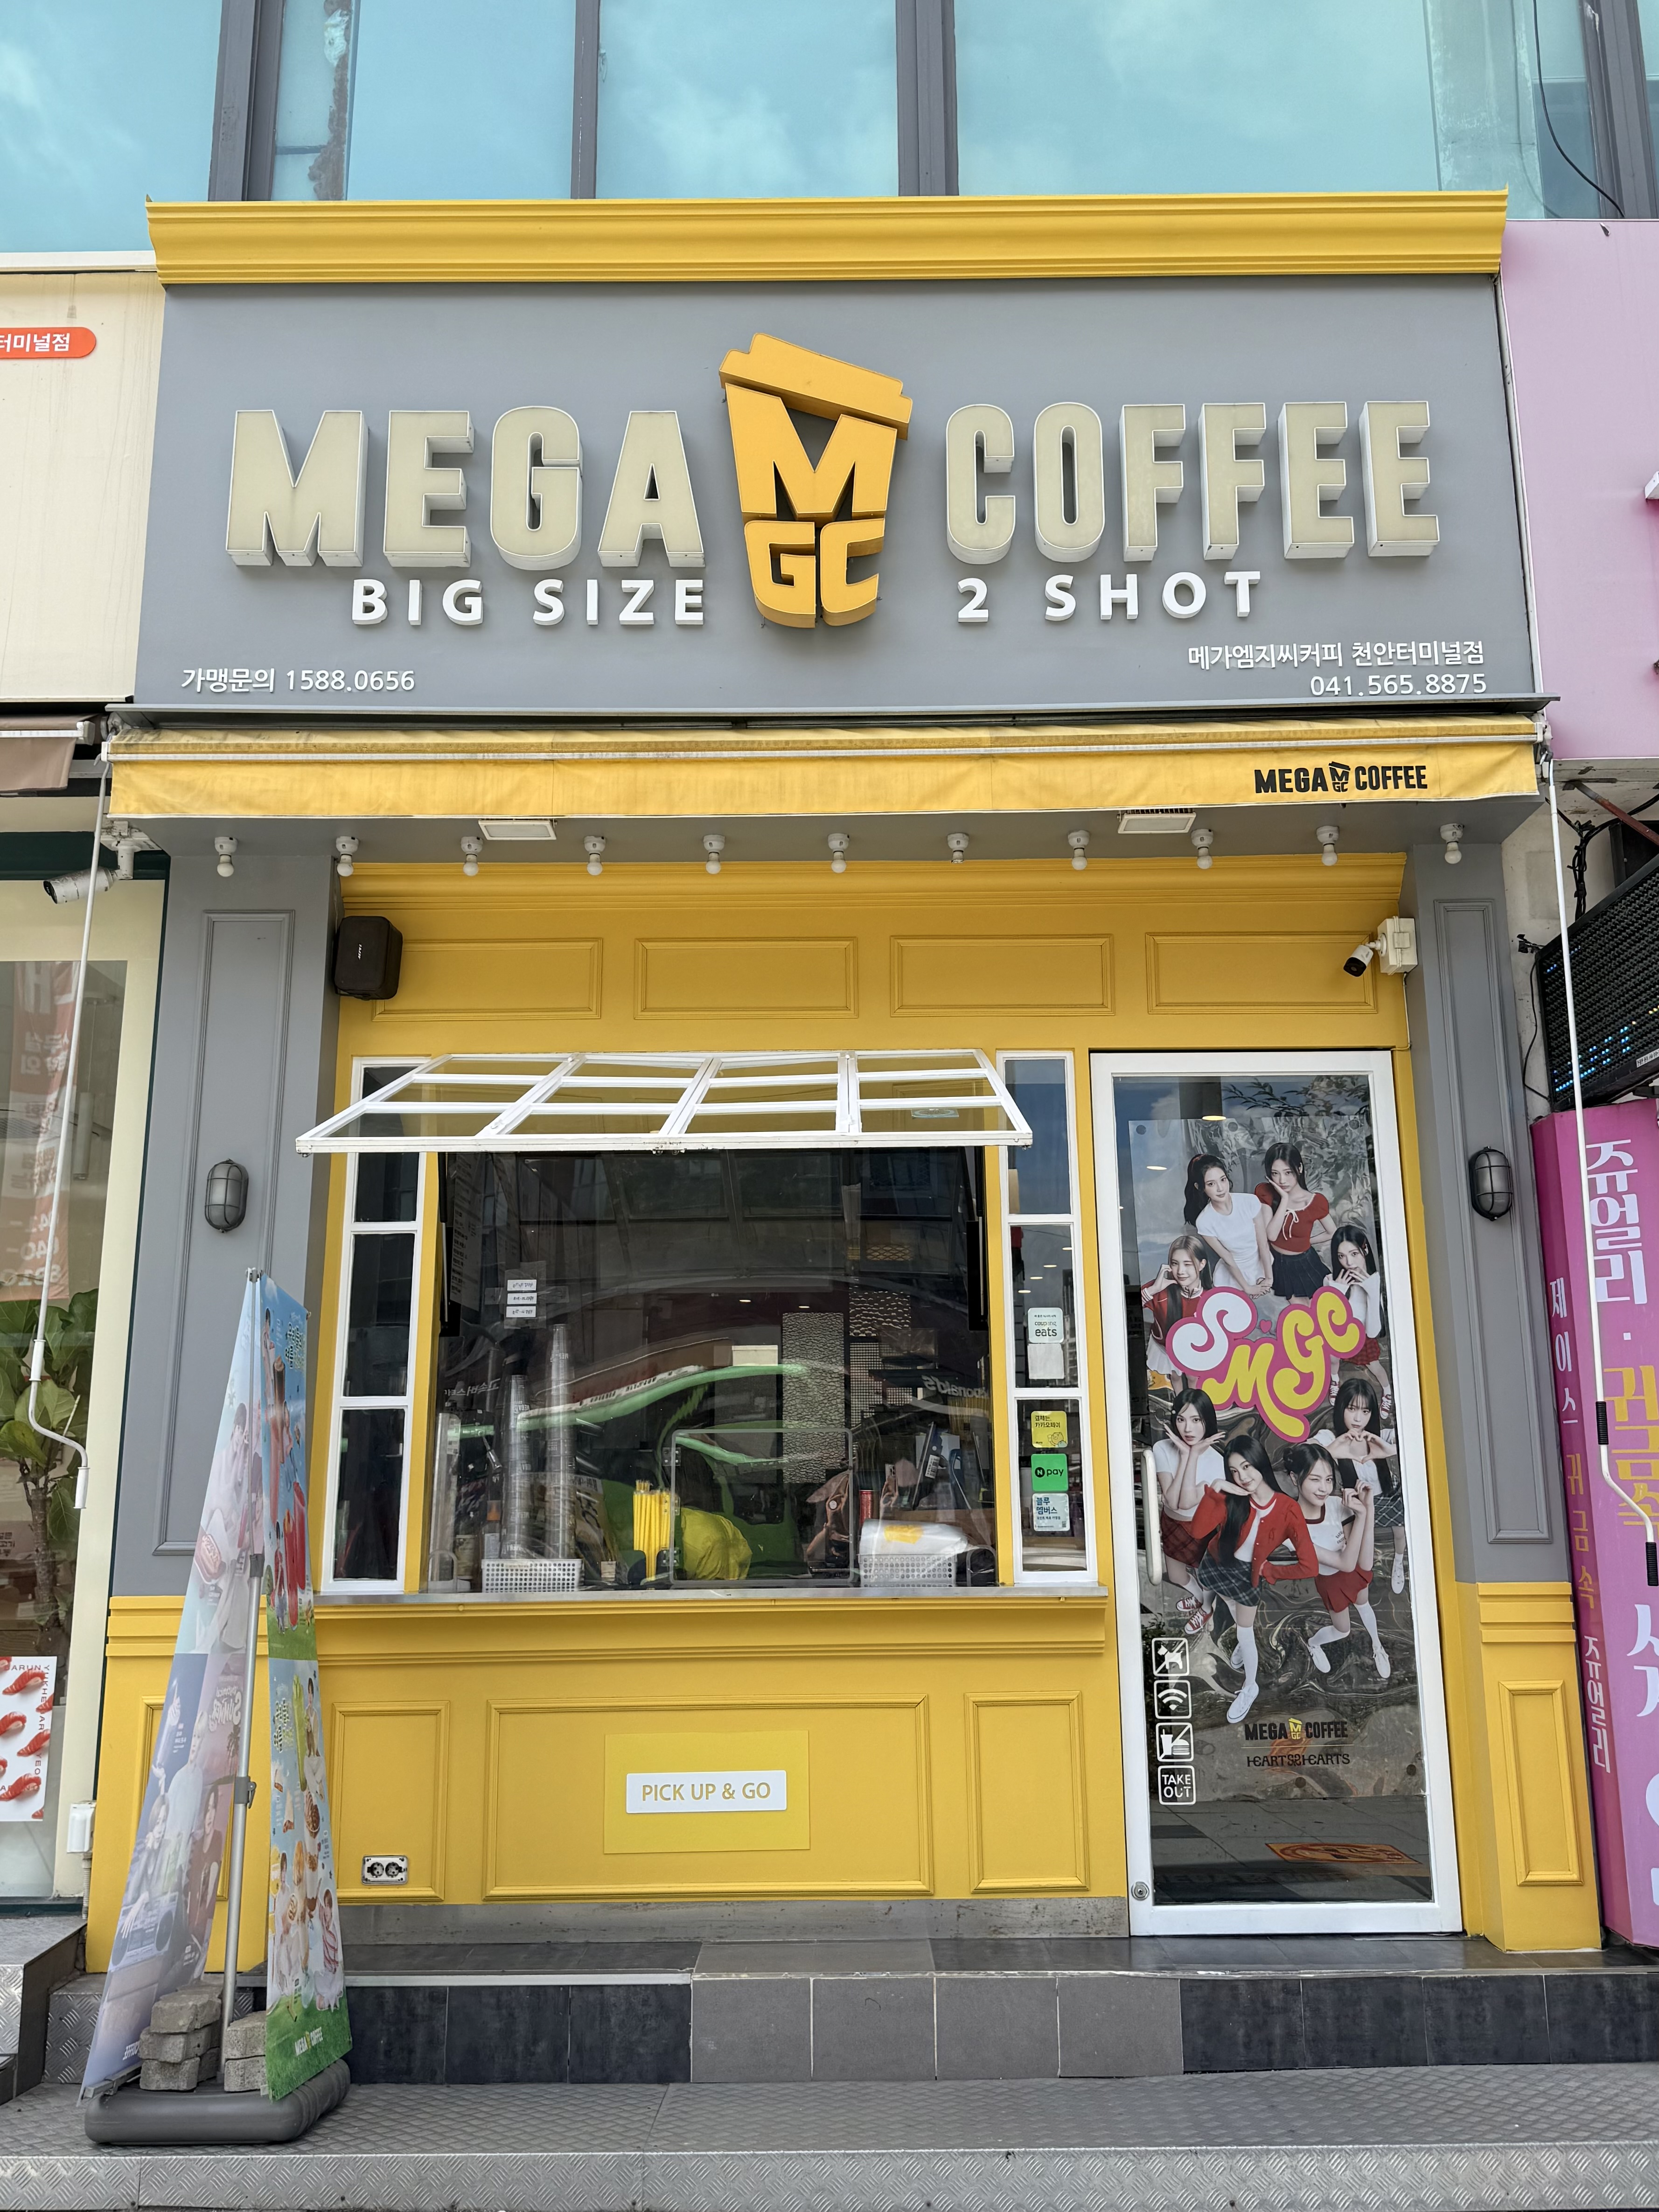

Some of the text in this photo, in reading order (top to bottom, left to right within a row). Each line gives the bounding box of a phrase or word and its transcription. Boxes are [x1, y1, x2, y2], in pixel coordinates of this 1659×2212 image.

[226, 400, 1440, 570] MEGA COFFEE
[352, 578, 704, 626] BIG SIZE
[957, 571, 1261, 623] 2 SHOT
[1188, 641, 1484, 670] 메가엠지씨커피 천안터미널점
[181, 668, 415, 692] 가맹문의 1588.0656
[1310, 673, 1487, 697] 041.565.8875
[1254, 765, 1428, 793] MEGA COFFEE
[1586, 1139, 1648, 1305] 쥬얼리
[1035, 1327, 1057, 1336] eats
[1549, 1277, 1578, 1424] 제이스
[1036, 1497, 1050, 1506] 블루
[1036, 1507, 1058, 1515] 멤버스
[1566, 1453, 1594, 1609] 귀금속
[1584, 1635, 1611, 1773] 쥬얼리
[1244, 1721, 1348, 1741] MEGA COFFEE
[642, 1782, 771, 1801] PICK UP & GO
[1162, 1774, 1191, 1785] TAKE
[1163, 1786, 1191, 1798] OUT
